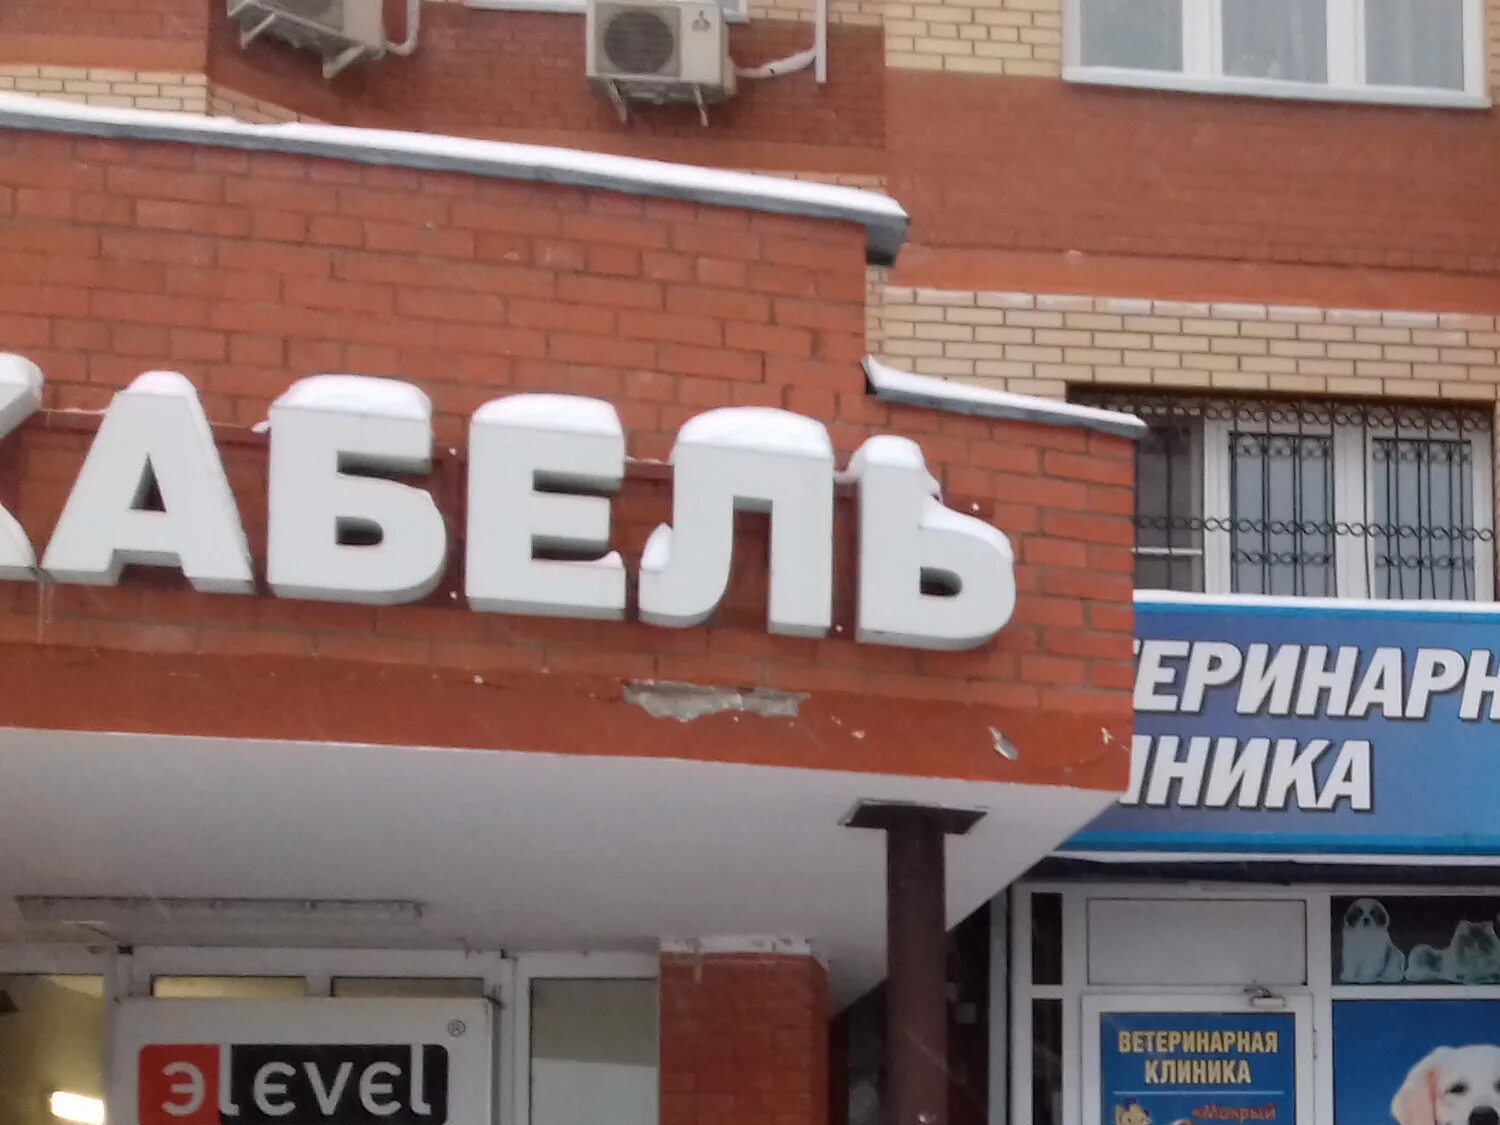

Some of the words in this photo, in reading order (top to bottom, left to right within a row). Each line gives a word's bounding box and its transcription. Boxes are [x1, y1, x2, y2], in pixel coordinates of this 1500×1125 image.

[0, 372, 1016, 650] АБЕЛЬ
[1118, 1031, 1279, 1054] ВЕТЕРИНАРНАЯ
[1144, 1060, 1252, 1085] КЛИНИКА
